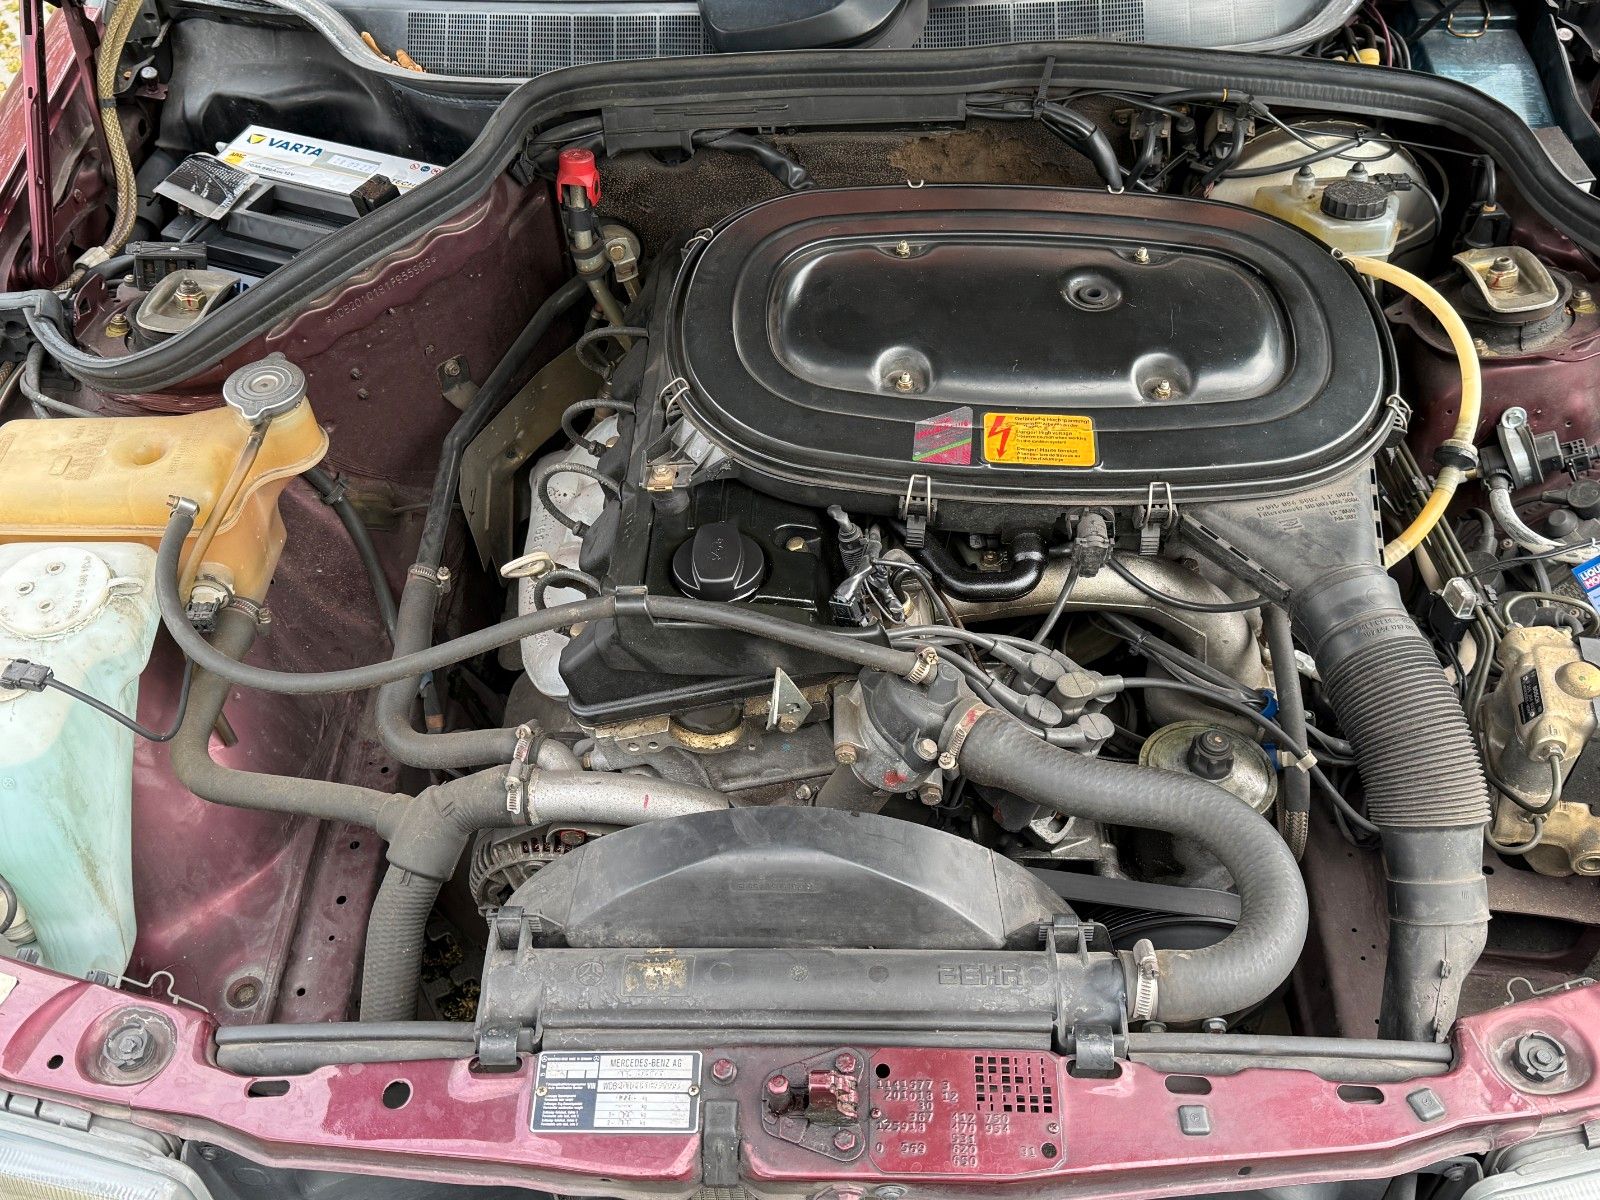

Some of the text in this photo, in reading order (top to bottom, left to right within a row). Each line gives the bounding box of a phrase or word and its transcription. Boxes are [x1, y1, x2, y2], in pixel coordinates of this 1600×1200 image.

[268, 137, 324, 157] VARTA
[610, 1058, 682, 1068] MERCEDES-BENZ AG
[943, 1080, 951, 1091] 3
[943, 1091, 958, 1102] 12
[919, 1100, 934, 1111] 30
[910, 1112, 934, 1122] 367
[952, 1112, 976, 1122] 412
[952, 1122, 977, 1134] 470
